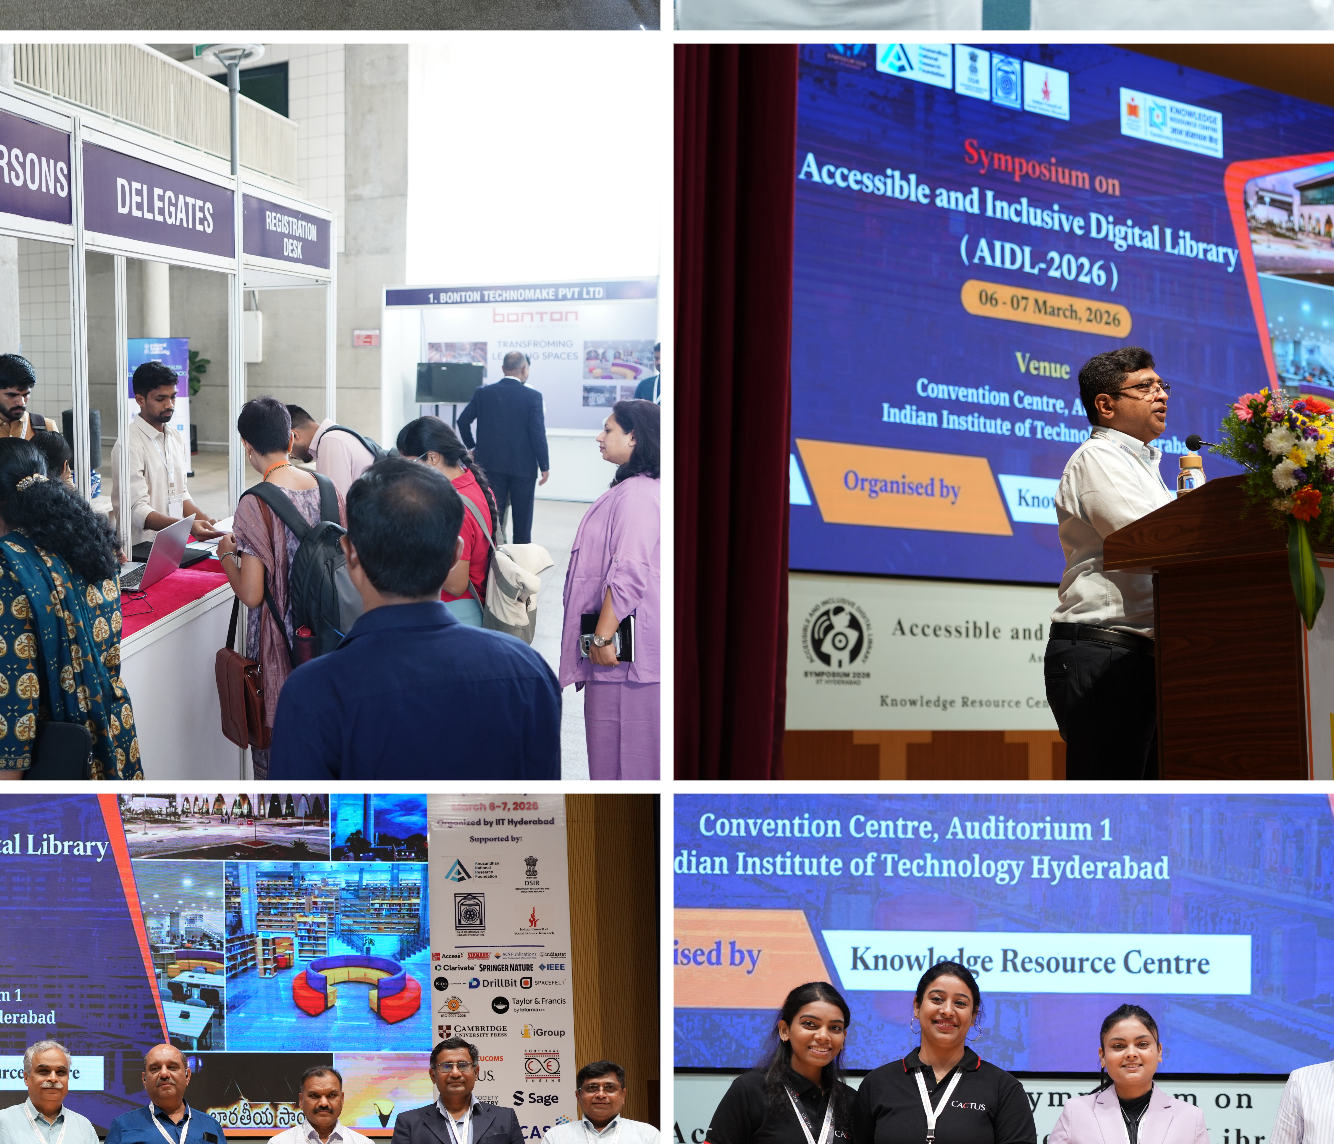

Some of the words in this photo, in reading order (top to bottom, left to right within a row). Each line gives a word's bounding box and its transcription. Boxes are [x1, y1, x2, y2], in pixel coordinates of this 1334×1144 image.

[964, 138, 1090, 191] Symposium
[1095, 174, 1121, 197] on
[117, 177, 214, 234] DELEGATES
[799, 152, 930, 205] Accessible
[935, 185, 980, 215] and
[985, 189, 1084, 236] Inclusive
[1090, 212, 1160, 253] Digital
[1165, 228, 1240, 273] Library
[266, 211, 317, 242] REGISTRATION
[283, 239, 302, 259] DESK
[428, 293, 437, 304] 1.
[440, 291, 480, 303] BONTON
[483, 288, 555, 302] TECHNOMAKE
[559, 288, 578, 299] PVT
[582, 286, 604, 298] LTD
[979, 289, 999, 309] 06
[1011, 295, 1029, 314] 07
[1033, 298, 1082, 323] March,
[1087, 306, 1121, 328] 2026
[497, 340, 573, 348] TRANSFROMING
[543, 352, 578, 360] SPACES
[1015, 351, 1070, 379] Venue
[882, 403, 937, 426] Indian
[942, 413, 1011, 435] Institute
[1014, 419, 1031, 437] of
[843, 469, 935, 499] Organised
[939, 478, 961, 504] by
[892, 618, 1001, 639] Accessible
[1011, 621, 1043, 641] and
[699, 813, 842, 841] Convention
[849, 814, 939, 843] Centre,
[946, 816, 1095, 842] Auditorium
[1100, 819, 1112, 842] 1
[26, 833, 109, 862] Library
[735, 851, 843, 877] Institute
[850, 852, 876, 878] of
[881, 854, 1024, 885] Technology
[1031, 855, 1169, 885] Hyderabad
[1001, 948, 1115, 974] Resource
[1124, 950, 1210, 975] Centre
[15, 989, 21, 1002] 1
[483, 979, 517, 987] DrillBit
[533, 1029, 565, 1038] iGroup
[529, 1093, 558, 1106] Sage
[951, 1100, 985, 1112] CACTUS
